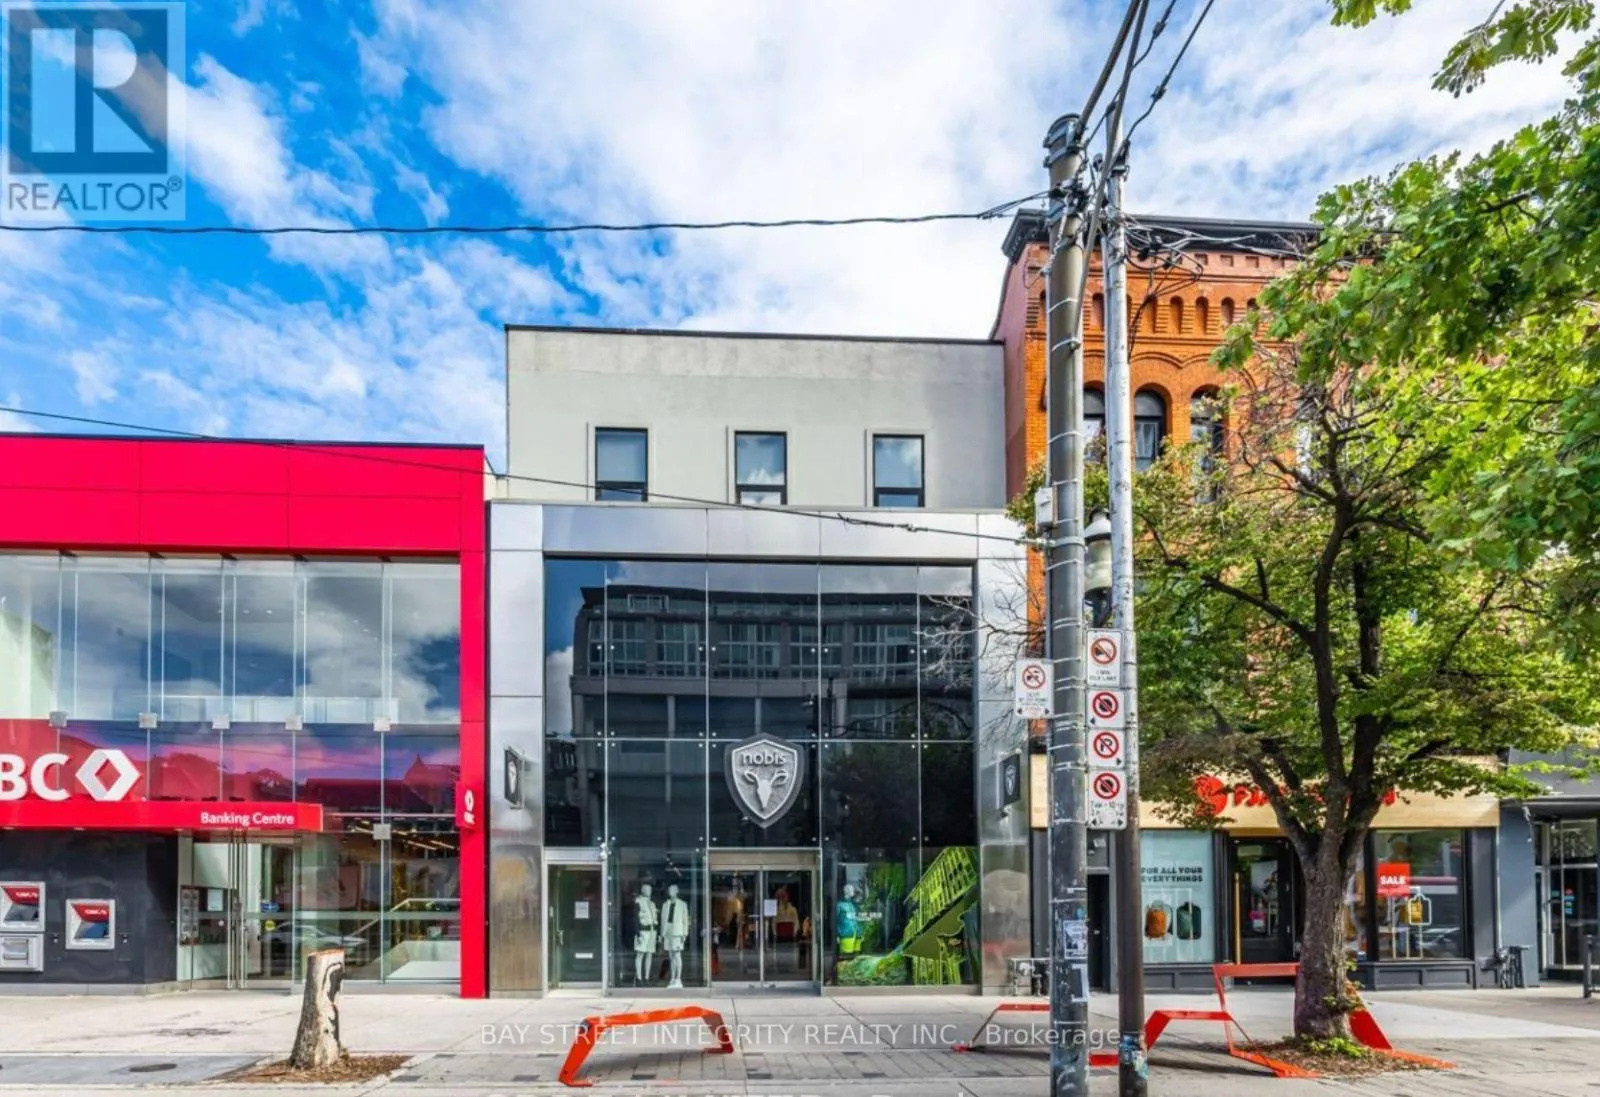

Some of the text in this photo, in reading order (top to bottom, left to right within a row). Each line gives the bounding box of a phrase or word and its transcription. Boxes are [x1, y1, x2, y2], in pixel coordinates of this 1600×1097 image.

[742, 749, 786, 766] nobis
[200, 811, 295, 826] Banking Centre
[1161, 866, 1177, 874] ALL
[1178, 866, 1203, 874] YOUR
[1380, 875, 1406, 885] SALE
